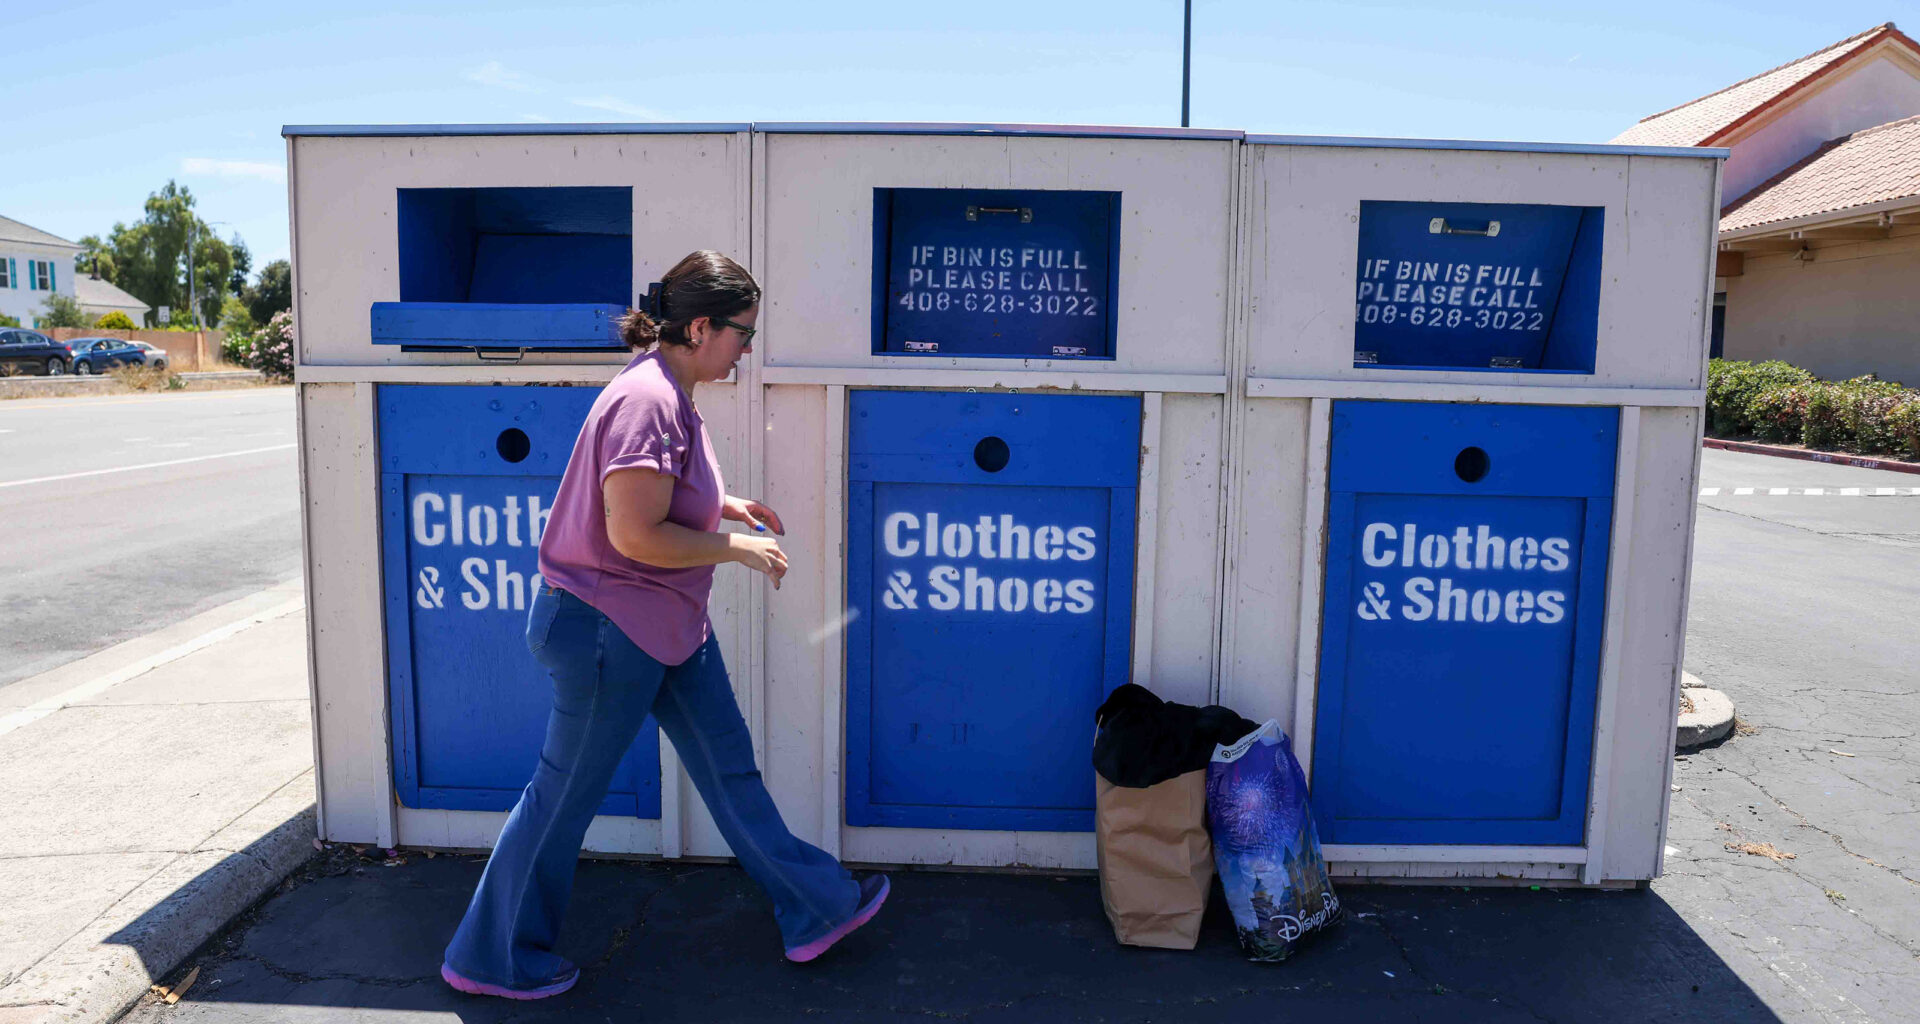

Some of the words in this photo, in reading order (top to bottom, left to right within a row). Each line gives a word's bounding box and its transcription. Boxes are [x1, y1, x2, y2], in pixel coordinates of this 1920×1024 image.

[913, 246, 935, 265] IF
[943, 247, 982, 266] BIN
[990, 248, 1013, 267] IS
[1021, 249, 1087, 270] FULL
[1364, 259, 1389, 279] IF
[1395, 261, 1439, 282] BIN
[1444, 263, 1470, 284] IS
[1475, 265, 1543, 287] FULL
[909, 268, 1011, 290] PLEASE
[1020, 271, 1088, 292] CALL
[1358, 281, 1465, 304] PLEASE
[1470, 286, 1538, 308] CALL
[900, 291, 1098, 316] 408-628-3022
[413, 492, 550, 547] Cloth
[884, 512, 1096, 561] Clothes
[1362, 522, 1570, 572] Clothes
[416, 566, 444, 609] &
[883, 570, 918, 610] &
[928, 565, 1095, 613] Shoes
[1357, 581, 1392, 621] &
[1402, 576, 1566, 624] Shoes
